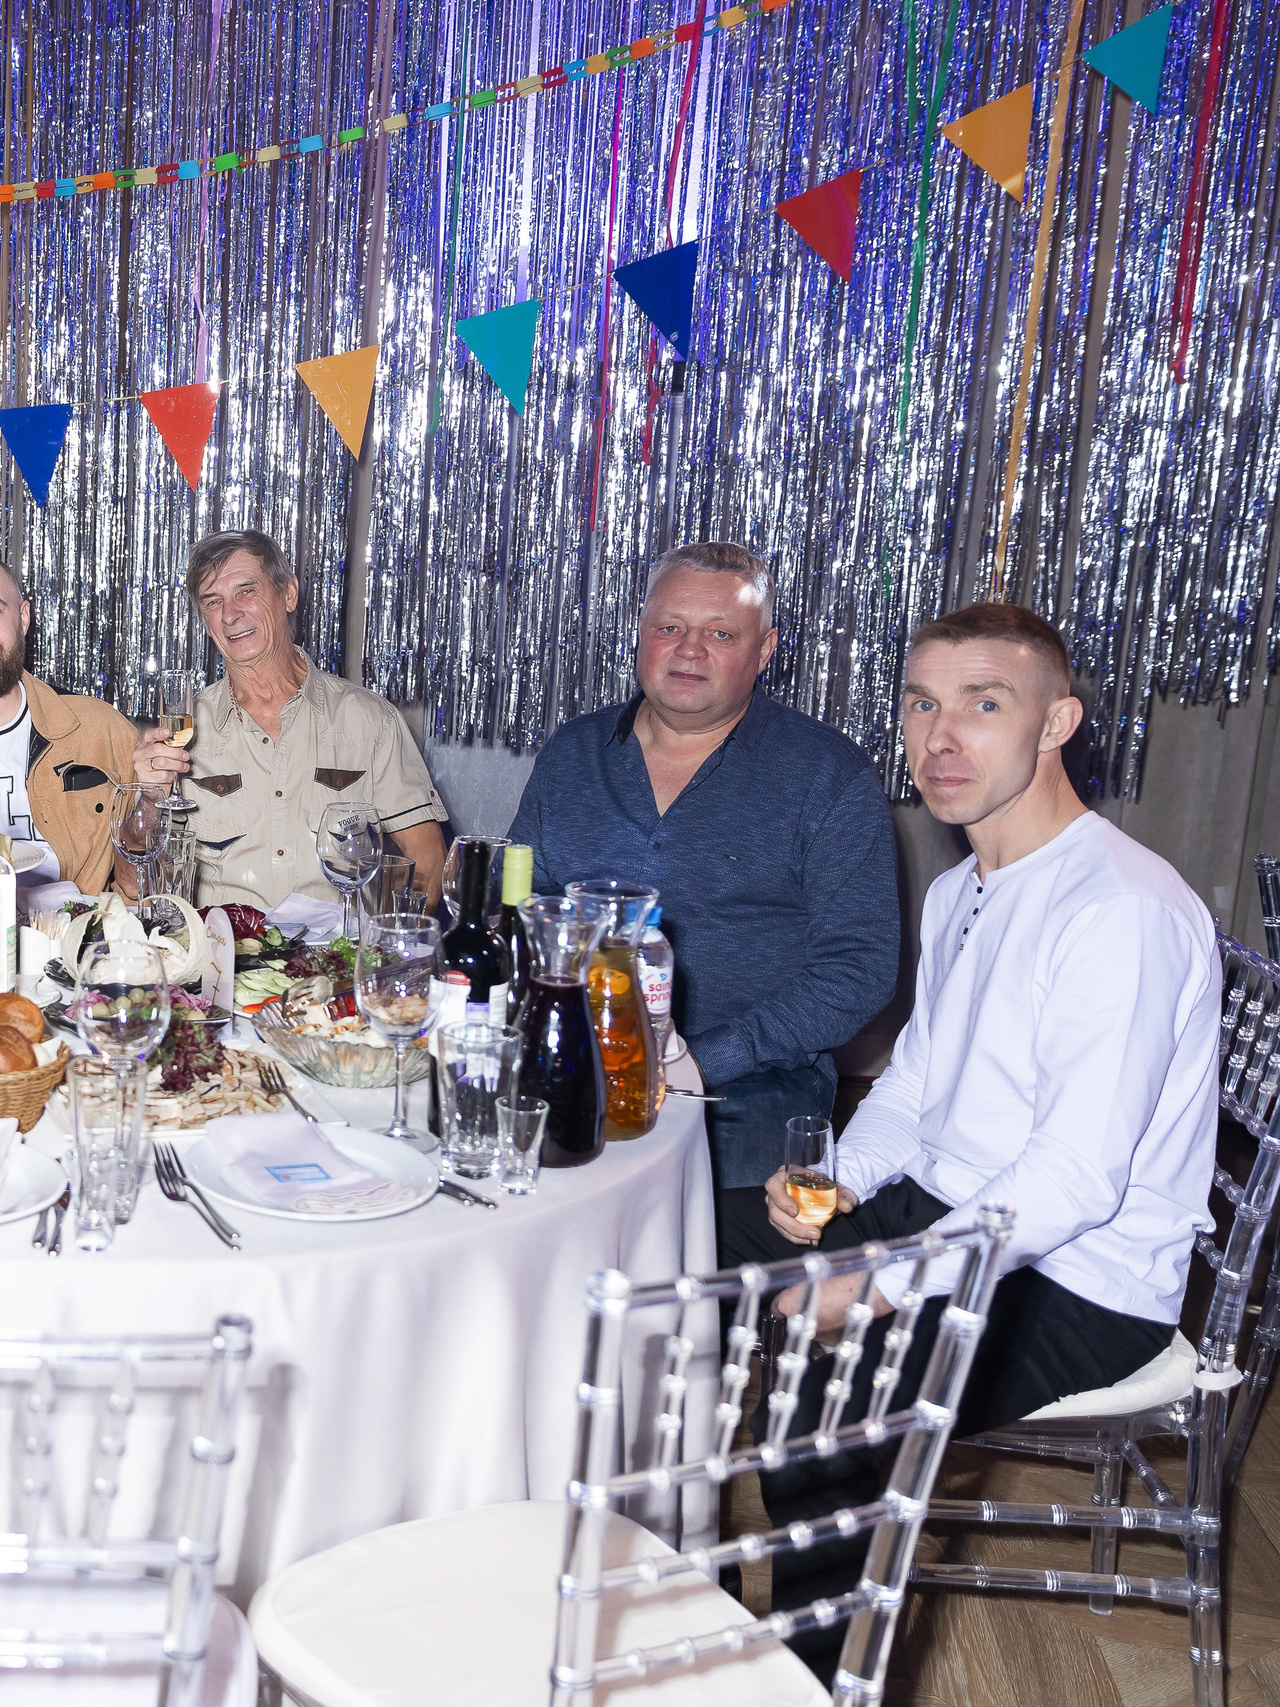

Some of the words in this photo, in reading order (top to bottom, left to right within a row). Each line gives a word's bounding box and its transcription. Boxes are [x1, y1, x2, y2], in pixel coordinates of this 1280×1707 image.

[338, 815, 360, 827] VOGUE
[649, 982, 672, 991] sain
[644, 992, 671, 1004] sprin
